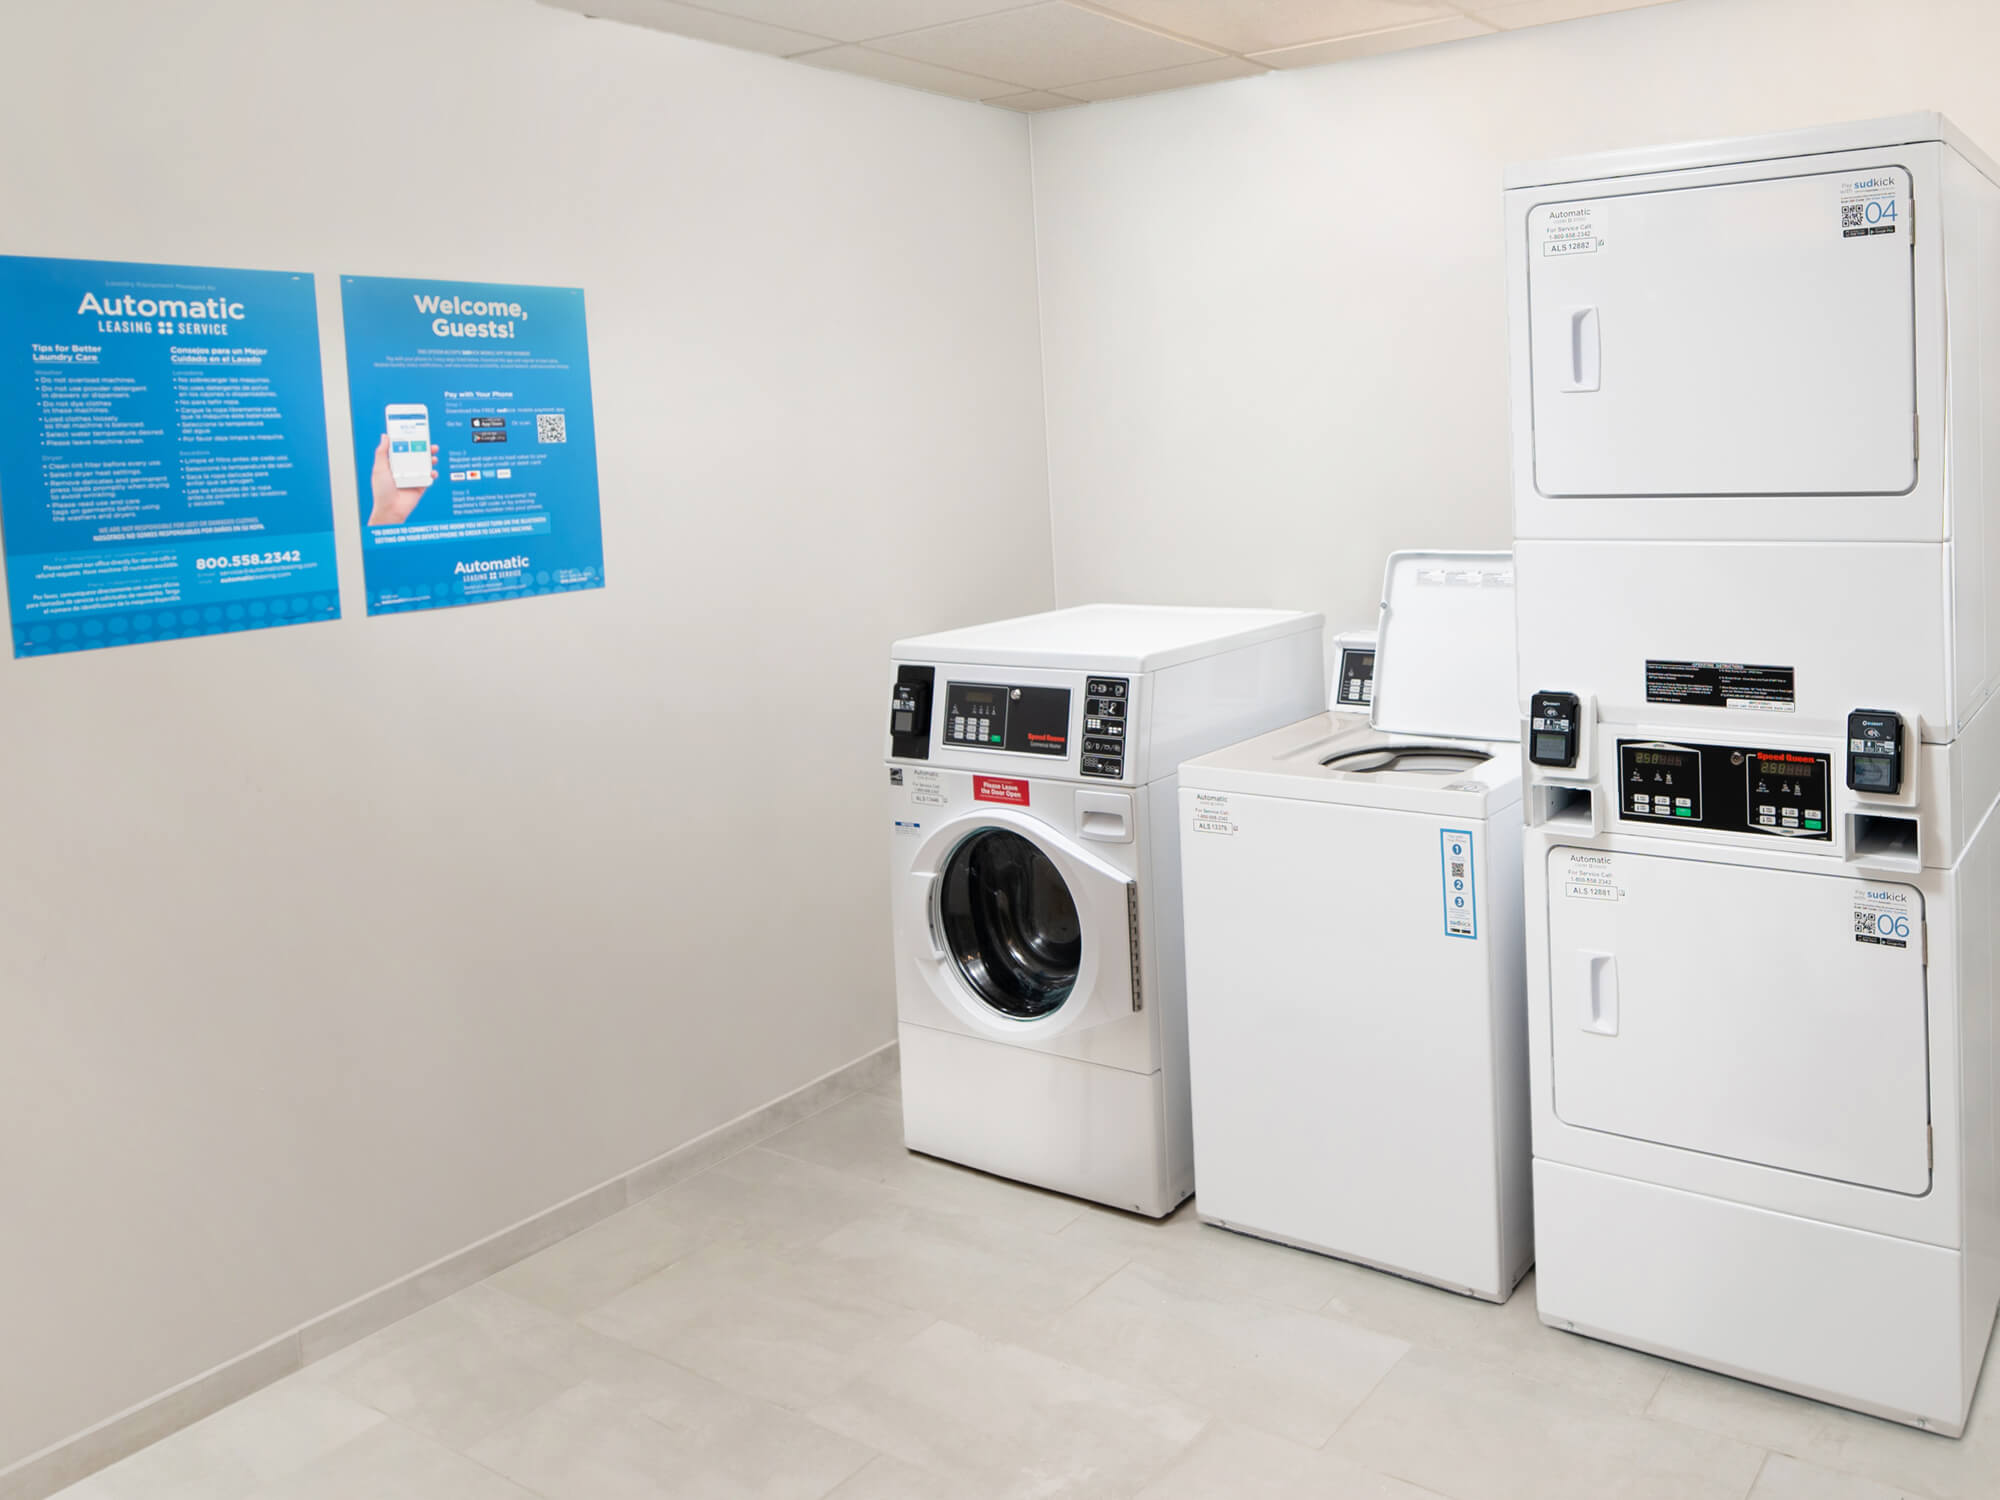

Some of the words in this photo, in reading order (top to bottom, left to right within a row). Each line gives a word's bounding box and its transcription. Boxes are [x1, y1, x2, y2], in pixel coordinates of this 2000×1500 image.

[1854, 177, 1895, 189] sudkick
[1549, 209, 1591, 219] Automatic
[1865, 200, 1898, 224] 04
[1552, 244, 1567, 252] ALS
[77, 292, 245, 320] Automatic
[413, 294, 528, 320] Welcome,
[98, 320, 152, 334] LEASING
[178, 322, 228, 336] SERVICE
[432, 318, 516, 338] Guests!
[32, 344, 54, 353] Tips
[55, 344, 70, 353] for
[72, 345, 102, 353] Better
[170, 347, 210, 355] Consejos
[211, 347, 231, 355] para
[33, 354, 74, 362] Laundry
[75, 354, 98, 362] Care
[170, 355, 208, 363] Cuidado
[210, 355, 220, 363] en
[232, 355, 262, 363] Lavado
[196, 550, 301, 570] 800.558.2342
[454, 556, 530, 575] Automatic
[1027, 733, 1045, 741] Speed
[1047, 734, 1065, 742] Queen
[1757, 752, 1785, 761] Speed
[1785, 754, 1815, 763] Queen
[983, 782, 1001, 790] Please
[1002, 783, 1018, 791] Leave
[1006, 790, 1022, 798] Open
[1196, 794, 1228, 803] Automatic
[1570, 855, 1612, 864] Automatic
[1867, 891, 1907, 902] sudkick
[1877, 913, 1910, 937] 06
